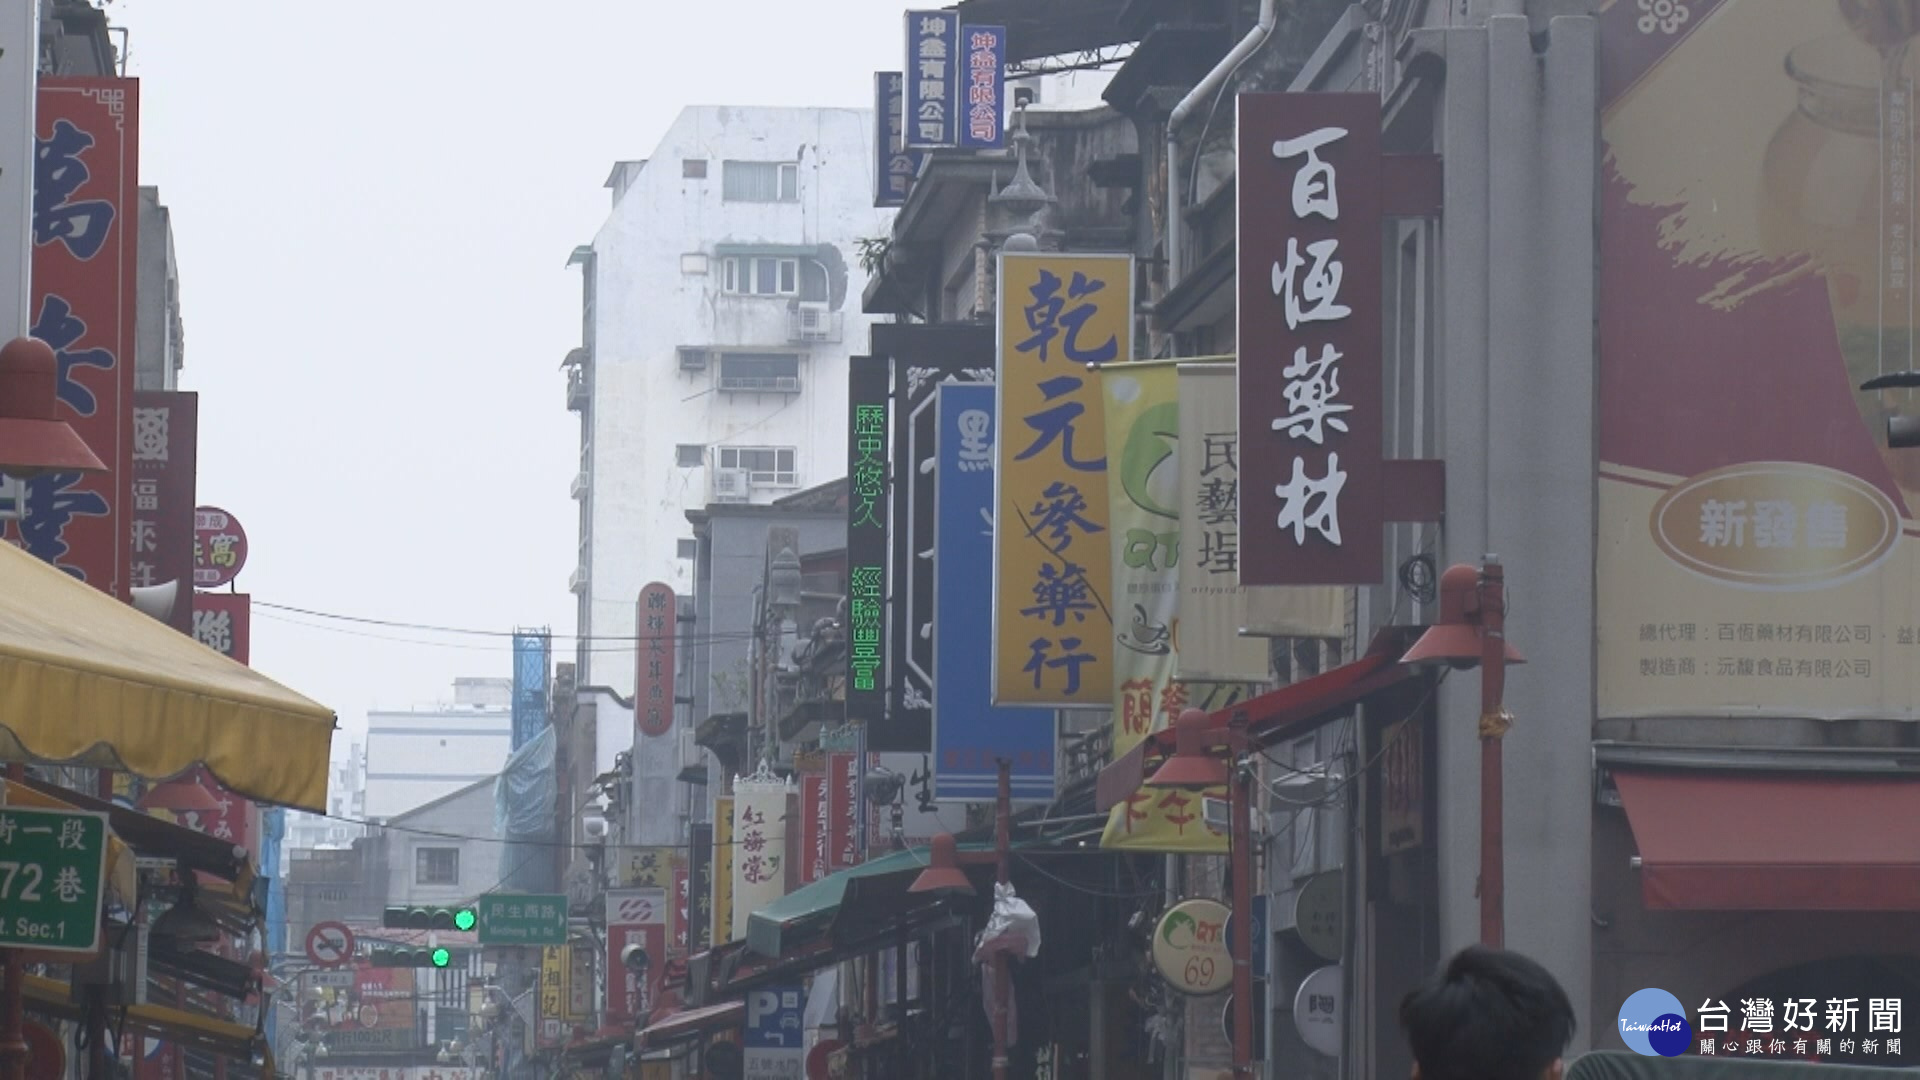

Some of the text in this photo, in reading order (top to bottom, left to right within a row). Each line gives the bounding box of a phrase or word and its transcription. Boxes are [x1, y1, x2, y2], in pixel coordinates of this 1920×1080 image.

[851, 404, 884, 690] 歷史悠久 經驗豐富
[1698, 498, 1848, 548] 新發售
[741, 804, 767, 885] 紅海棠
[491, 903, 556, 919] 民生西路
[1184, 955, 1216, 986] 69
